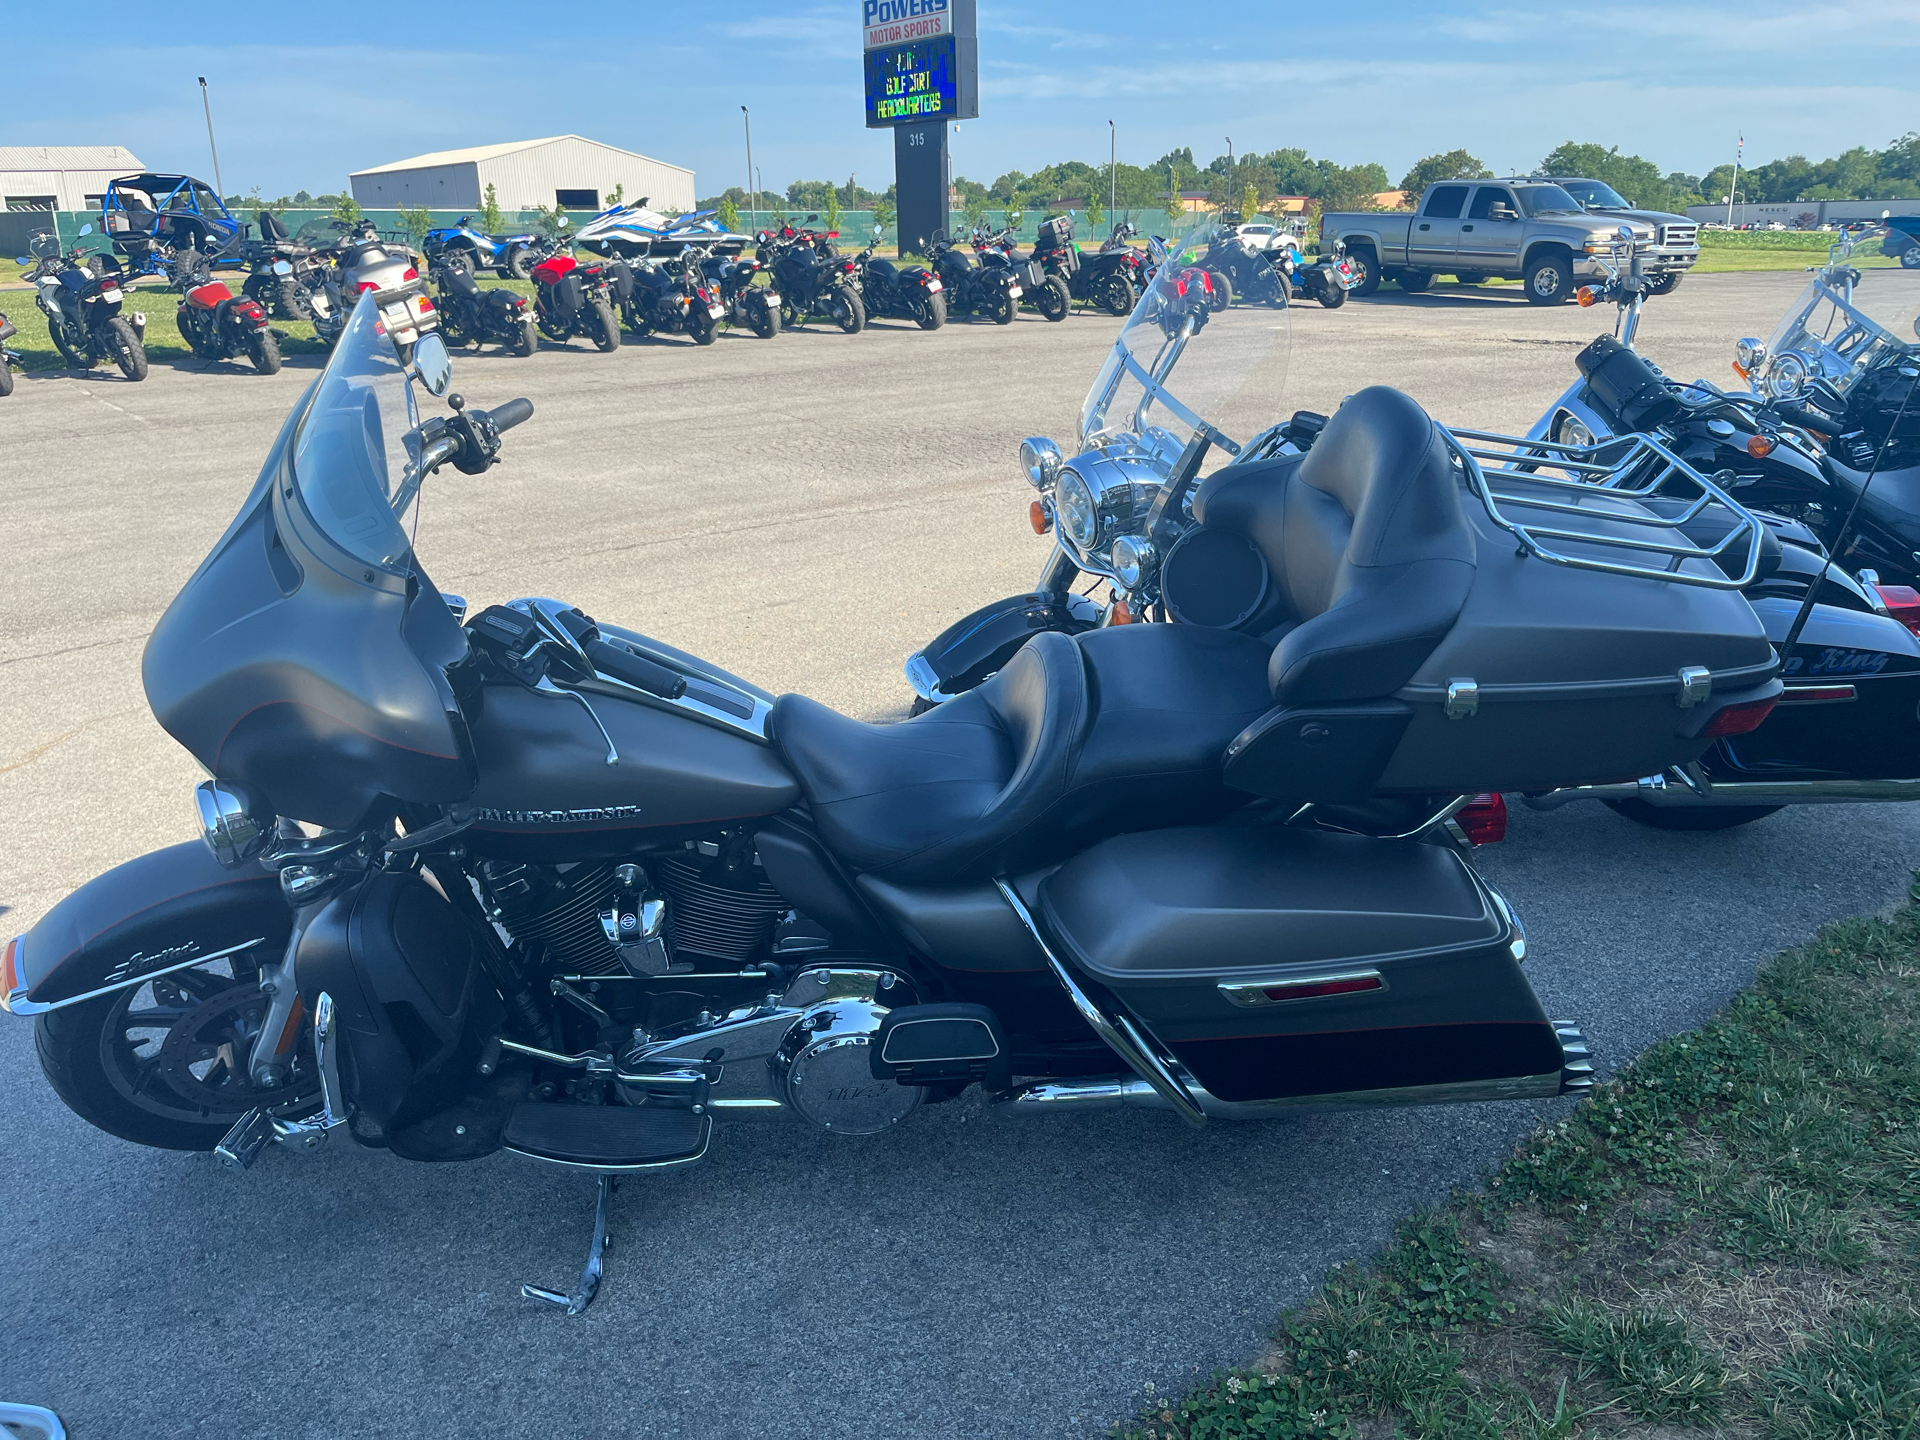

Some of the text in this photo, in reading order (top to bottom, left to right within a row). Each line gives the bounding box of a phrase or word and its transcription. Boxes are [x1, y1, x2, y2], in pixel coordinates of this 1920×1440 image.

[870, 17, 941, 45] MOTOR SPORTS
[909, 132, 925, 147] 315
[208, 221, 230, 236] HONDA
[1810, 648, 1889, 675] King
